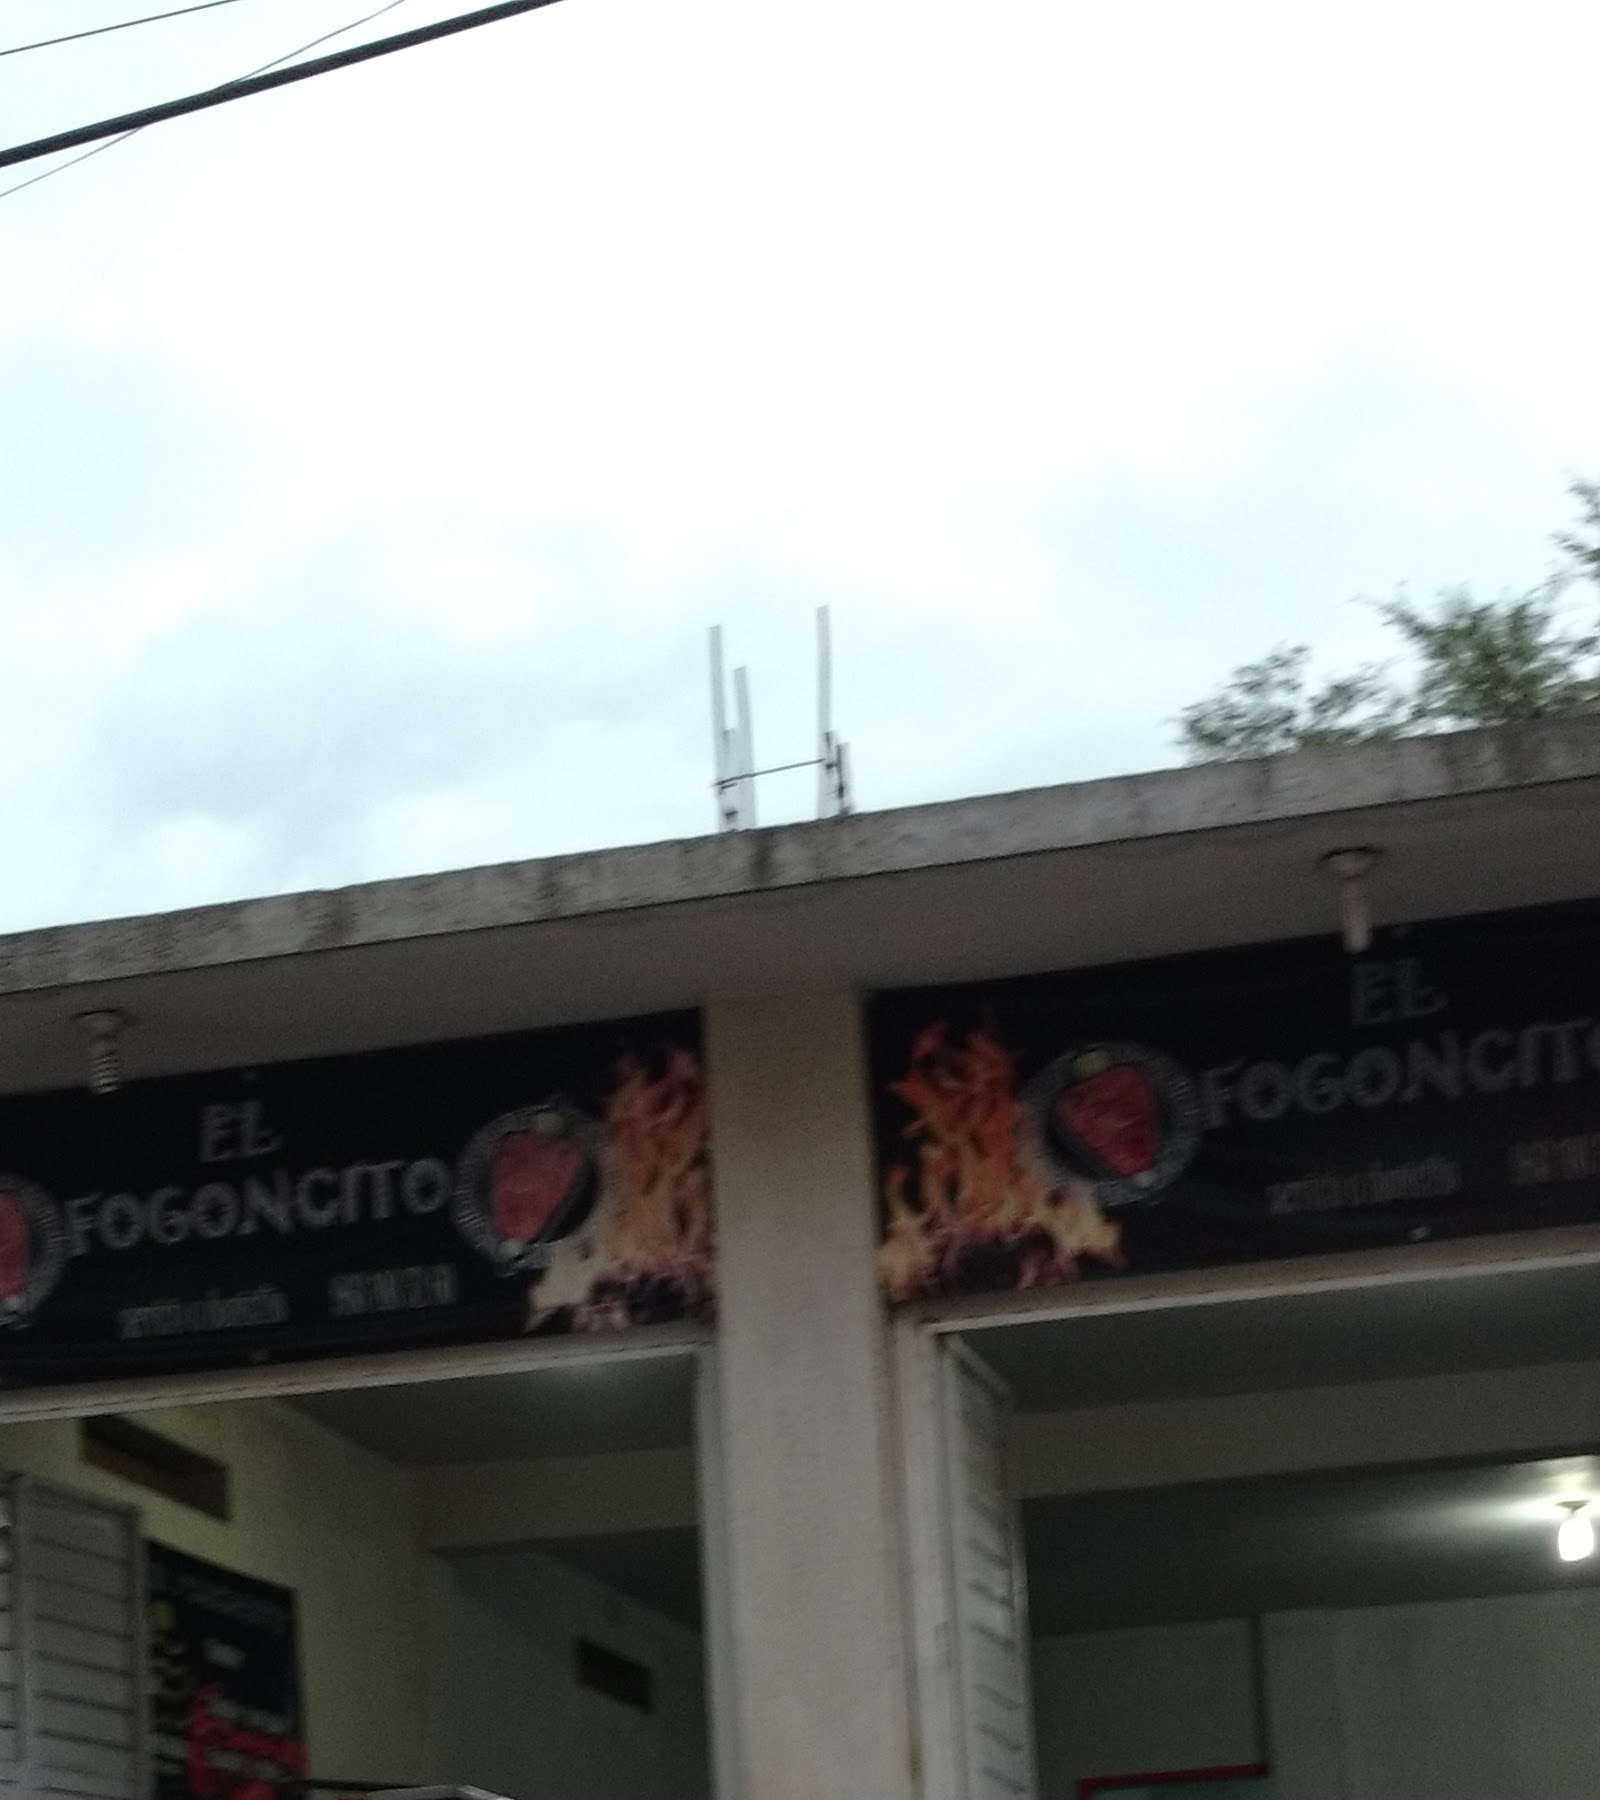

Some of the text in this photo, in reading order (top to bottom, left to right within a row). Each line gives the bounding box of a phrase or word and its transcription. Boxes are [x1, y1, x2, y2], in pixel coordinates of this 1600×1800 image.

[1350, 957, 1450, 1028] EL
[198, 1098, 283, 1163] EL
[63, 1156, 454, 1259] FOGONCITO
